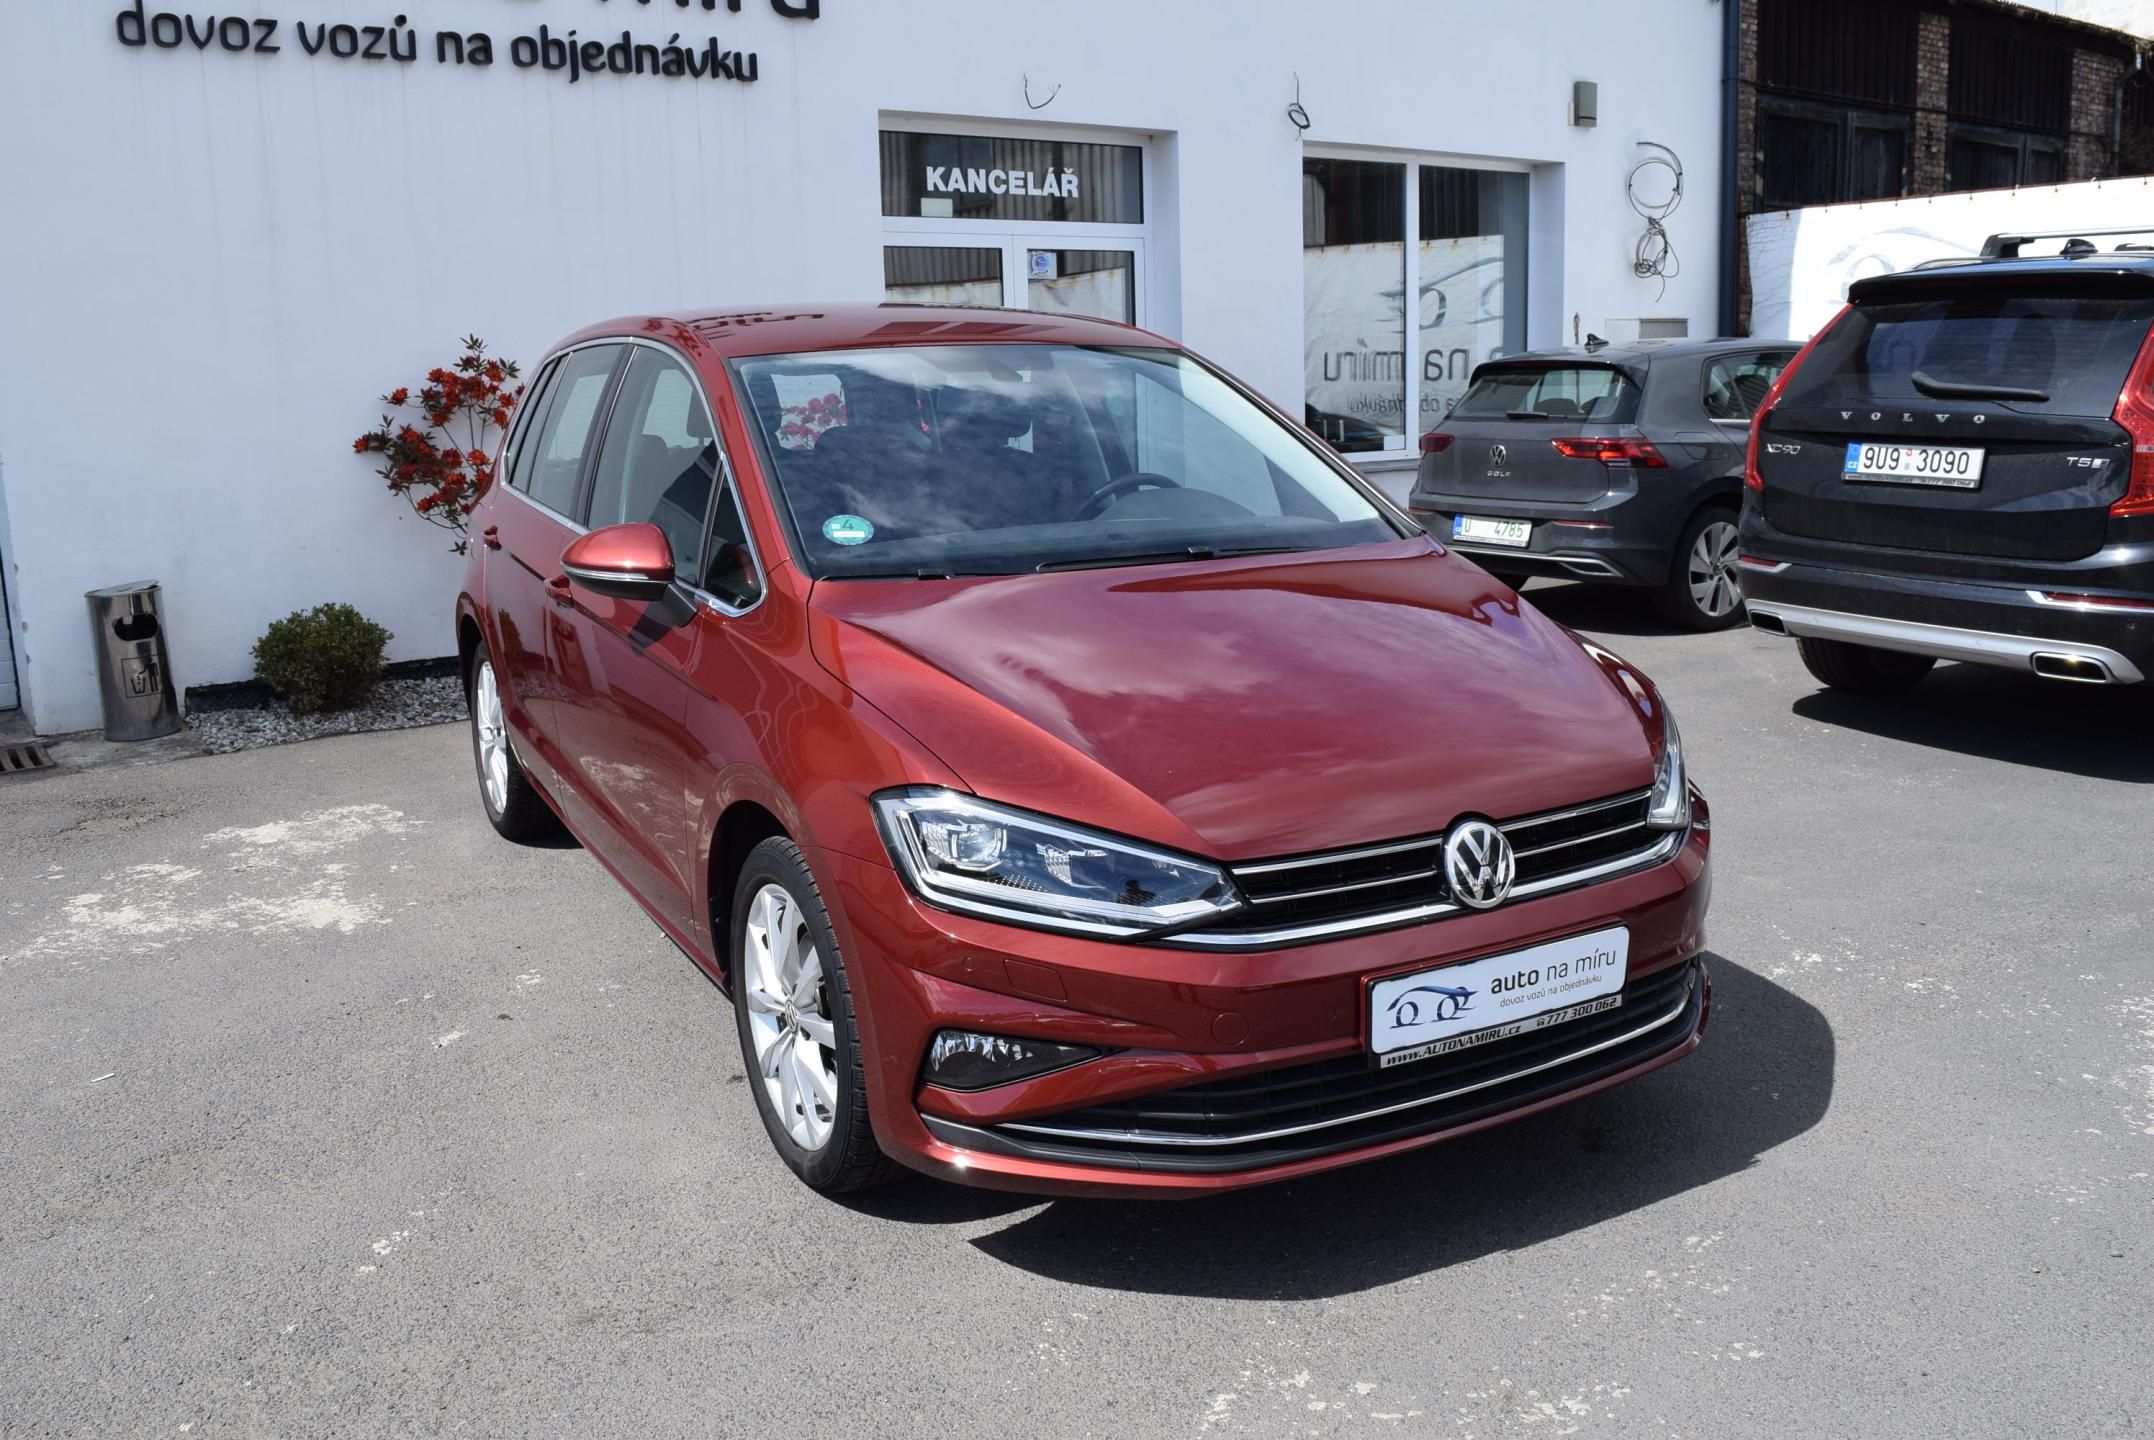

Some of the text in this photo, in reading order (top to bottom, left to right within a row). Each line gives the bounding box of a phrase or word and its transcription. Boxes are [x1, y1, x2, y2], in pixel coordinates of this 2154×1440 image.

[115, 0, 281, 53] dovoz
[436, 31, 493, 65] na
[511, 24, 758, 83] objednávku
[925, 165, 1079, 198] KANCELÁŘ
[1840, 411, 1985, 424] VOLVO
[1766, 443, 1801, 455] XC90
[1863, 447, 1901, 470] 9U9
[1916, 449, 1970, 475] 3090
[842, 519, 855, 530] 4
[1494, 521, 1524, 539] 4785
[1491, 948, 1616, 994] auto na míru
[1500, 996, 1525, 1008] dovoz
[1548, 986, 1558, 996] na
[1559, 974, 1602, 993] objednávku
[1386, 997, 1617, 1066] www.AUTONAMIRU.cz 777 300 062
